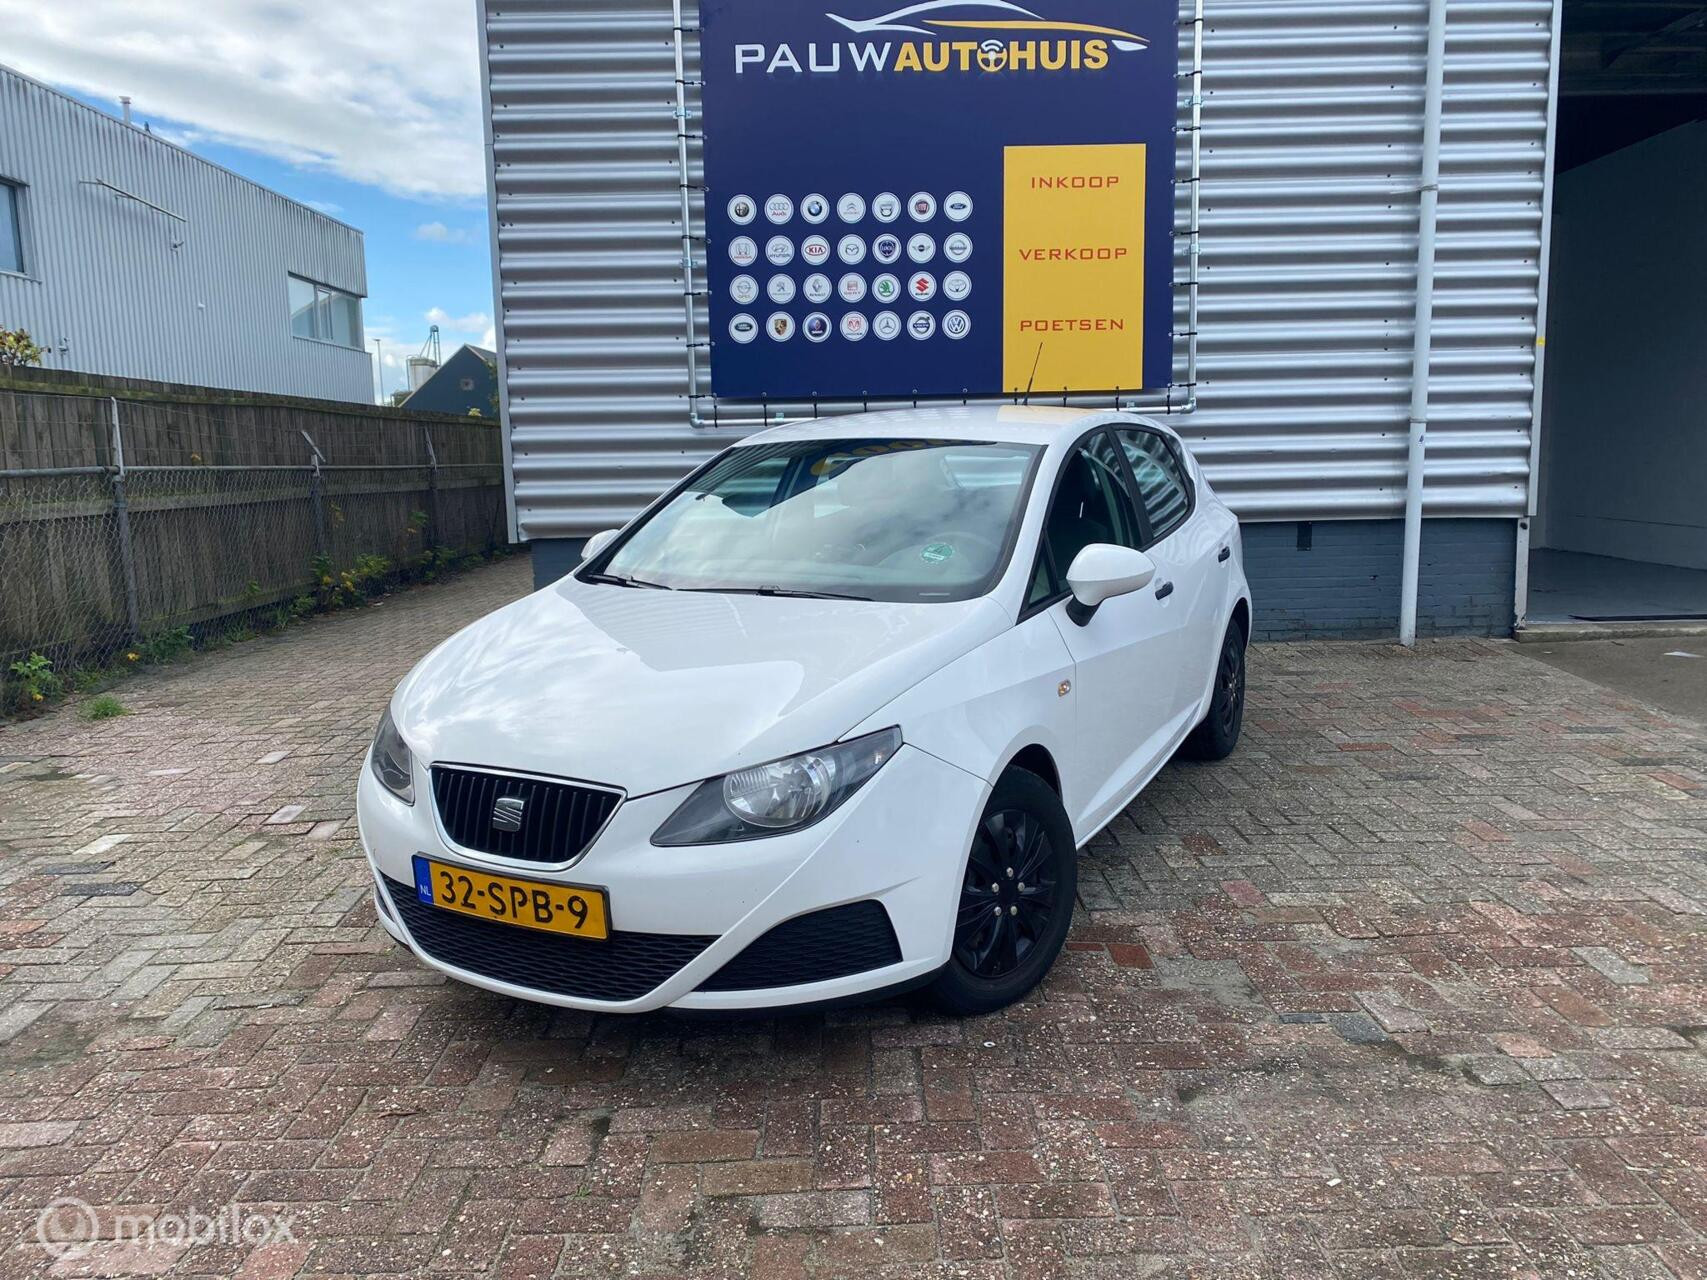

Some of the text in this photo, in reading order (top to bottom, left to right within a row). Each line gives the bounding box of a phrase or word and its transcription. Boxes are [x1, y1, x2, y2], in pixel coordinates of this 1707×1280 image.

[1031, 176, 1119, 189] INKOOP
[808, 246, 823, 254] KIA
[1019, 248, 1127, 260] VERKOOP
[1020, 319, 1124, 332] POETSEN
[419, 884, 431, 896] NL
[439, 871, 588, 929] 32-SPB-9
